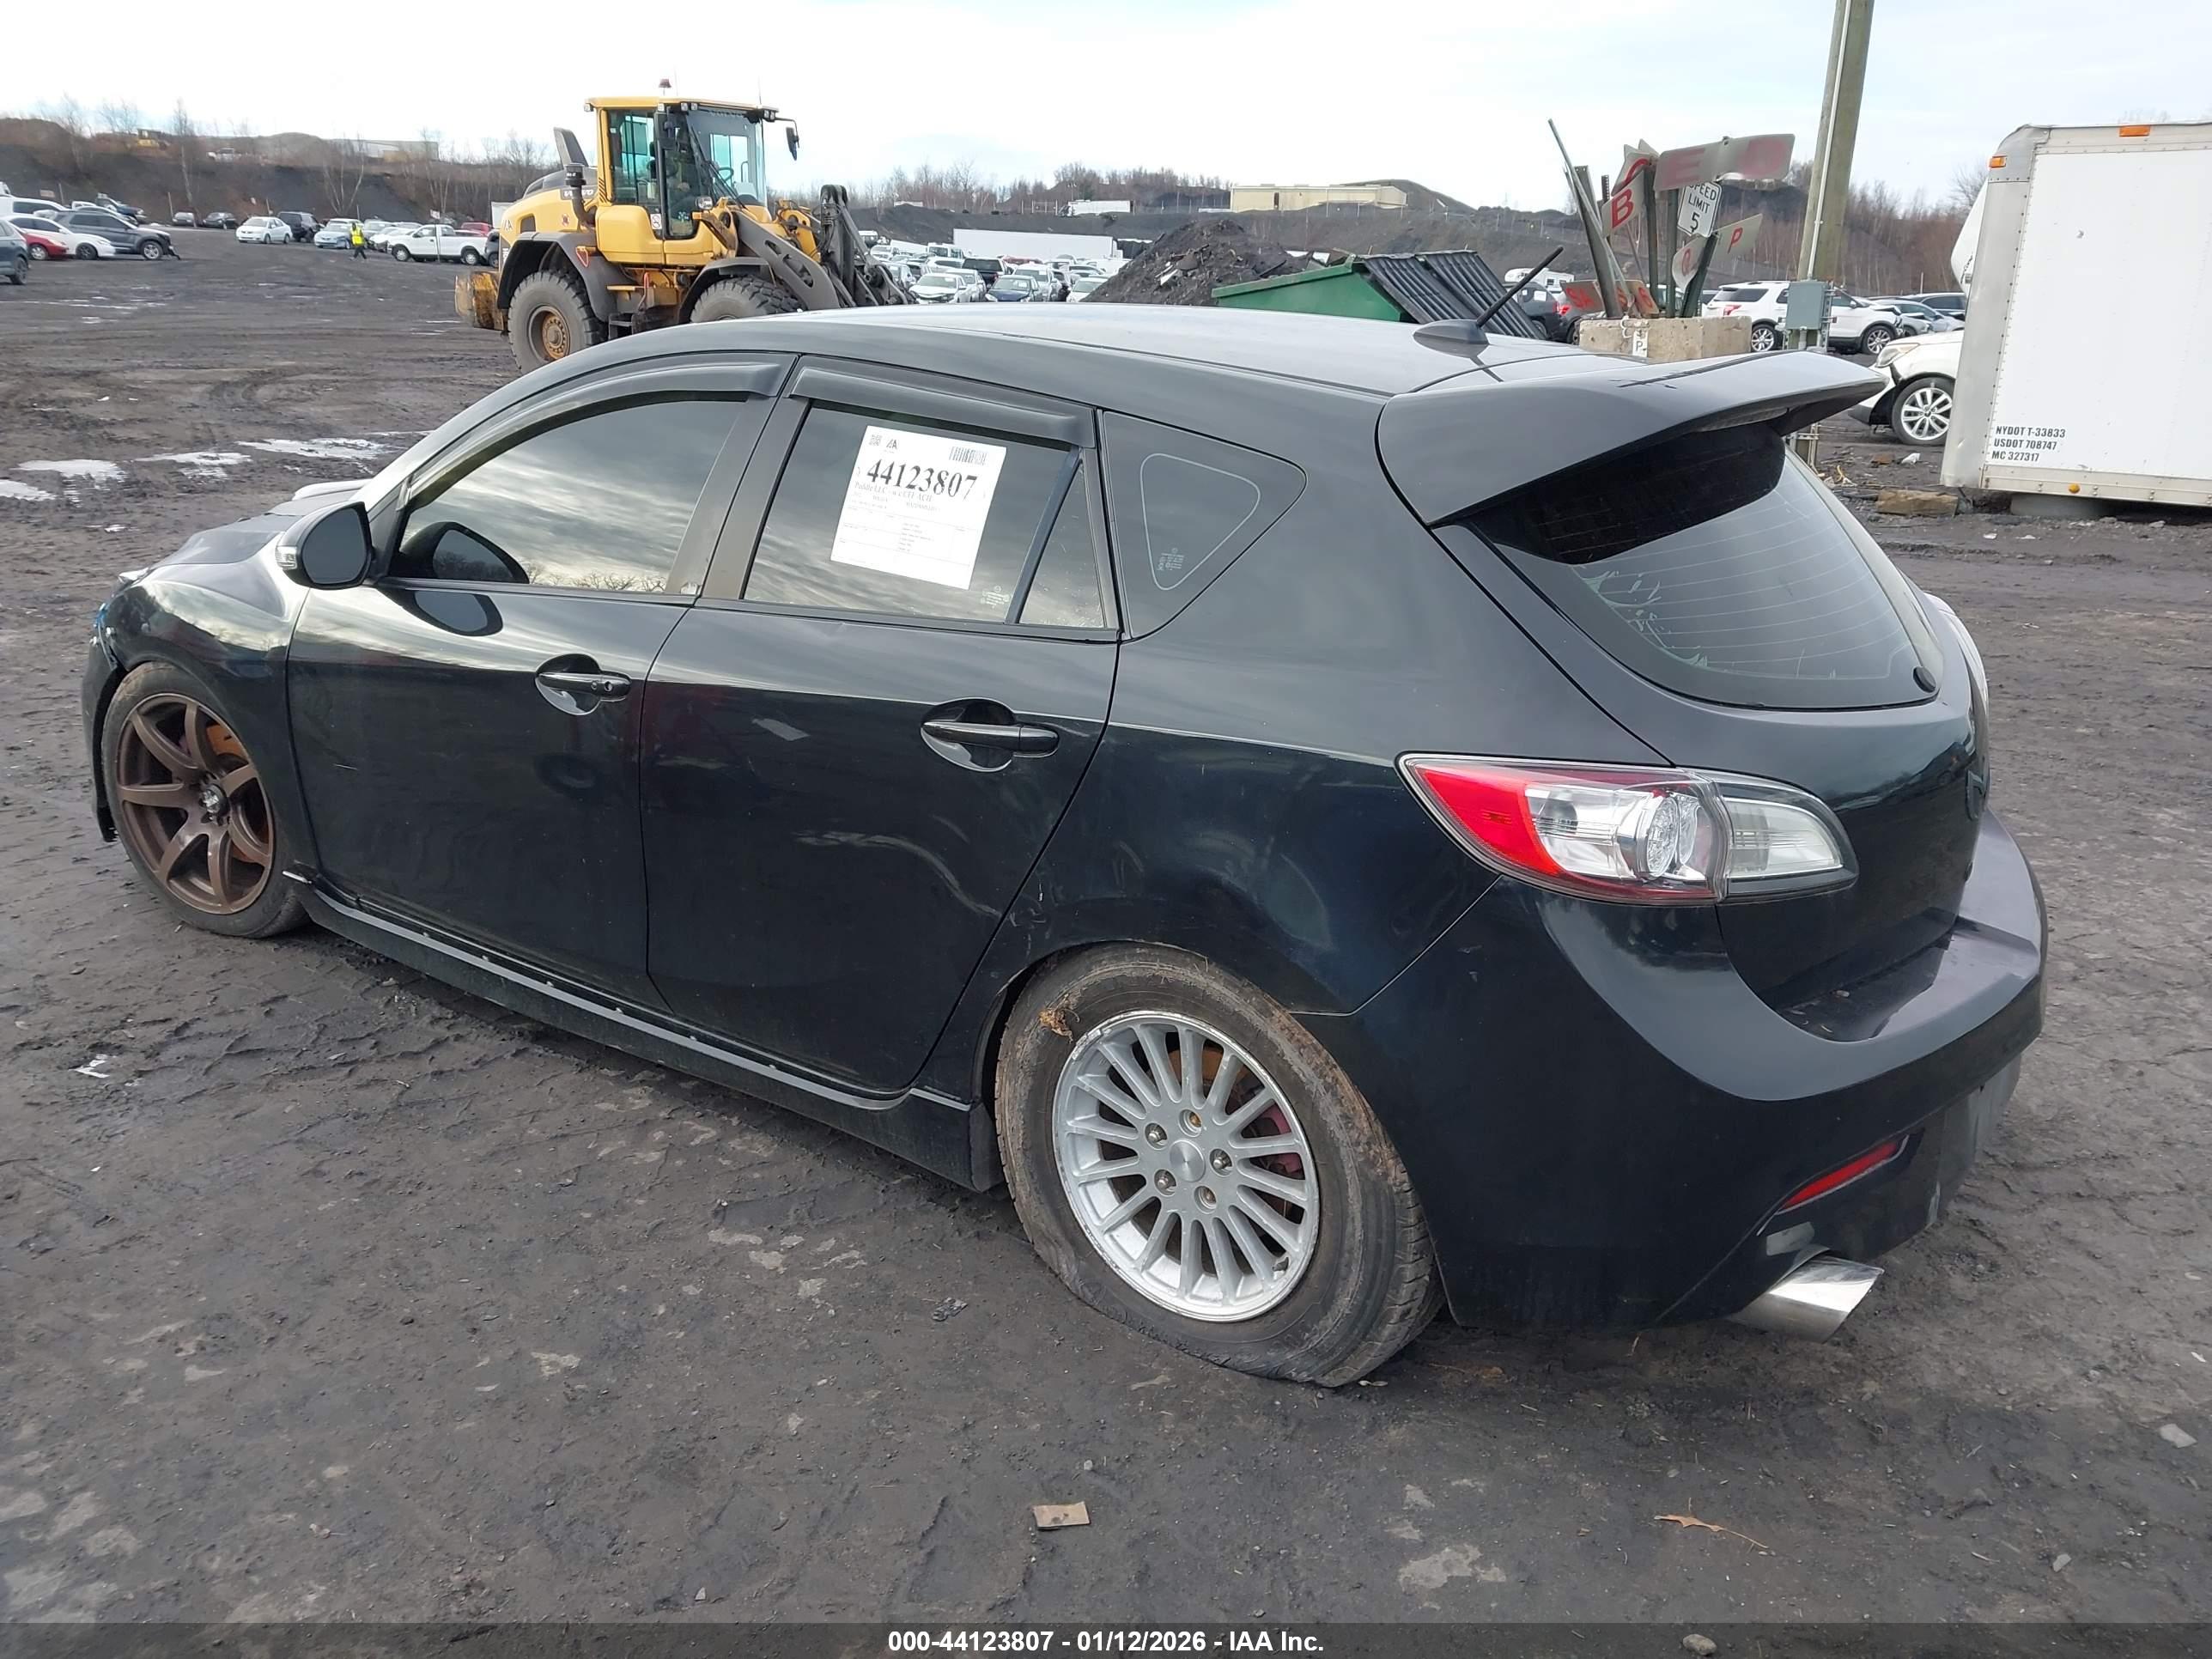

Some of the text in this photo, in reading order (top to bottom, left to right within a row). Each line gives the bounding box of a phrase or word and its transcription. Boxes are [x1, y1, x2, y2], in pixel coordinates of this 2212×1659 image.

[1611, 188, 1635, 229] B
[1688, 193, 1711, 214] LIMIT
[1690, 212, 1700, 233] 5
[1728, 227, 1743, 254] P
[1996, 426, 2066, 438] NYDOT T-33833
[1994, 438, 2057, 451] USDOT 708747
[1991, 450, 2039, 462] MC 327317
[866, 459, 978, 501] 44123807
